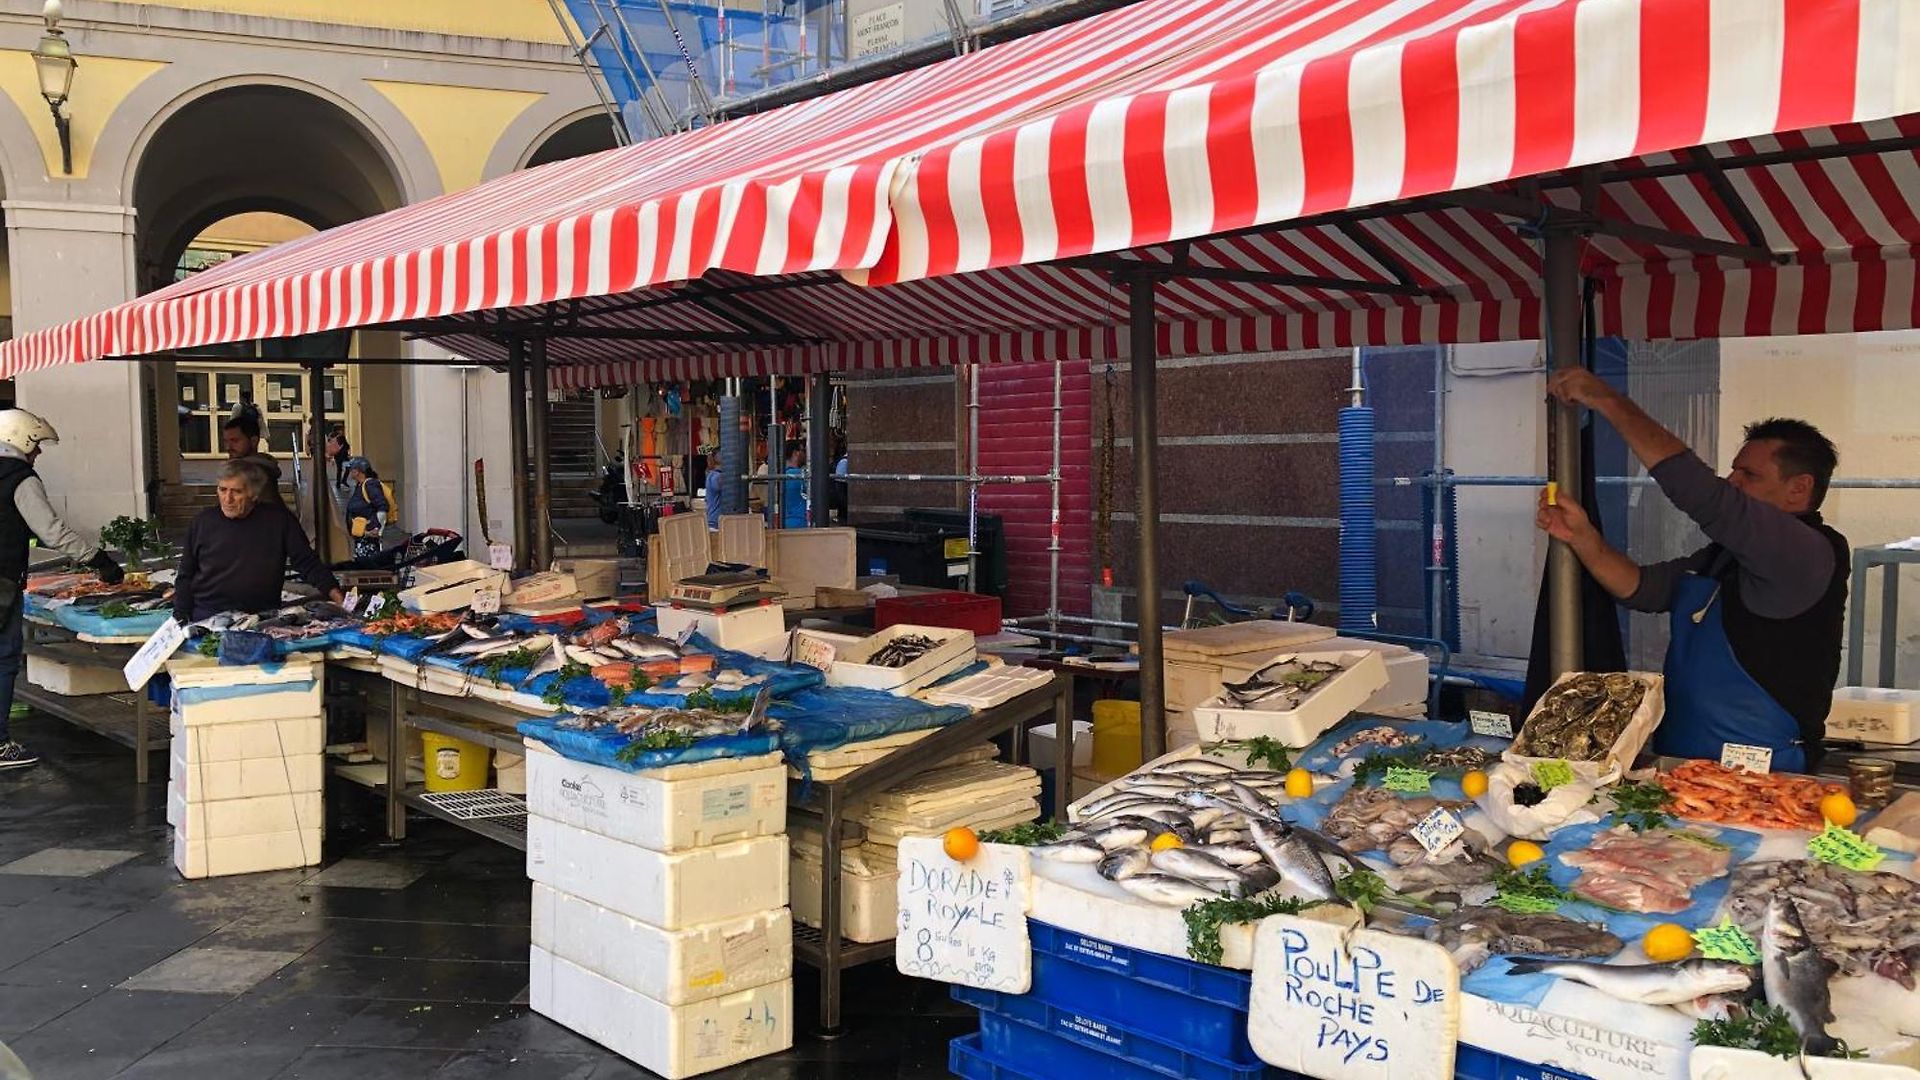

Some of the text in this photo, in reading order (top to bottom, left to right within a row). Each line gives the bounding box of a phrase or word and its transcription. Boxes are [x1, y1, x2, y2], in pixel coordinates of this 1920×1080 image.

[908, 858, 1000, 902] DORADE
[927, 893, 1006, 935] ROYALE
[917, 927, 934, 962] 8
[1285, 973, 1375, 1025] ROCHE
[1412, 980, 1445, 1004] DE
[1317, 1016, 1389, 1065] PAYS
[1486, 1001, 1657, 1057] AQUACULTURE
[1566, 1040, 1662, 1075] SCOTLAND
